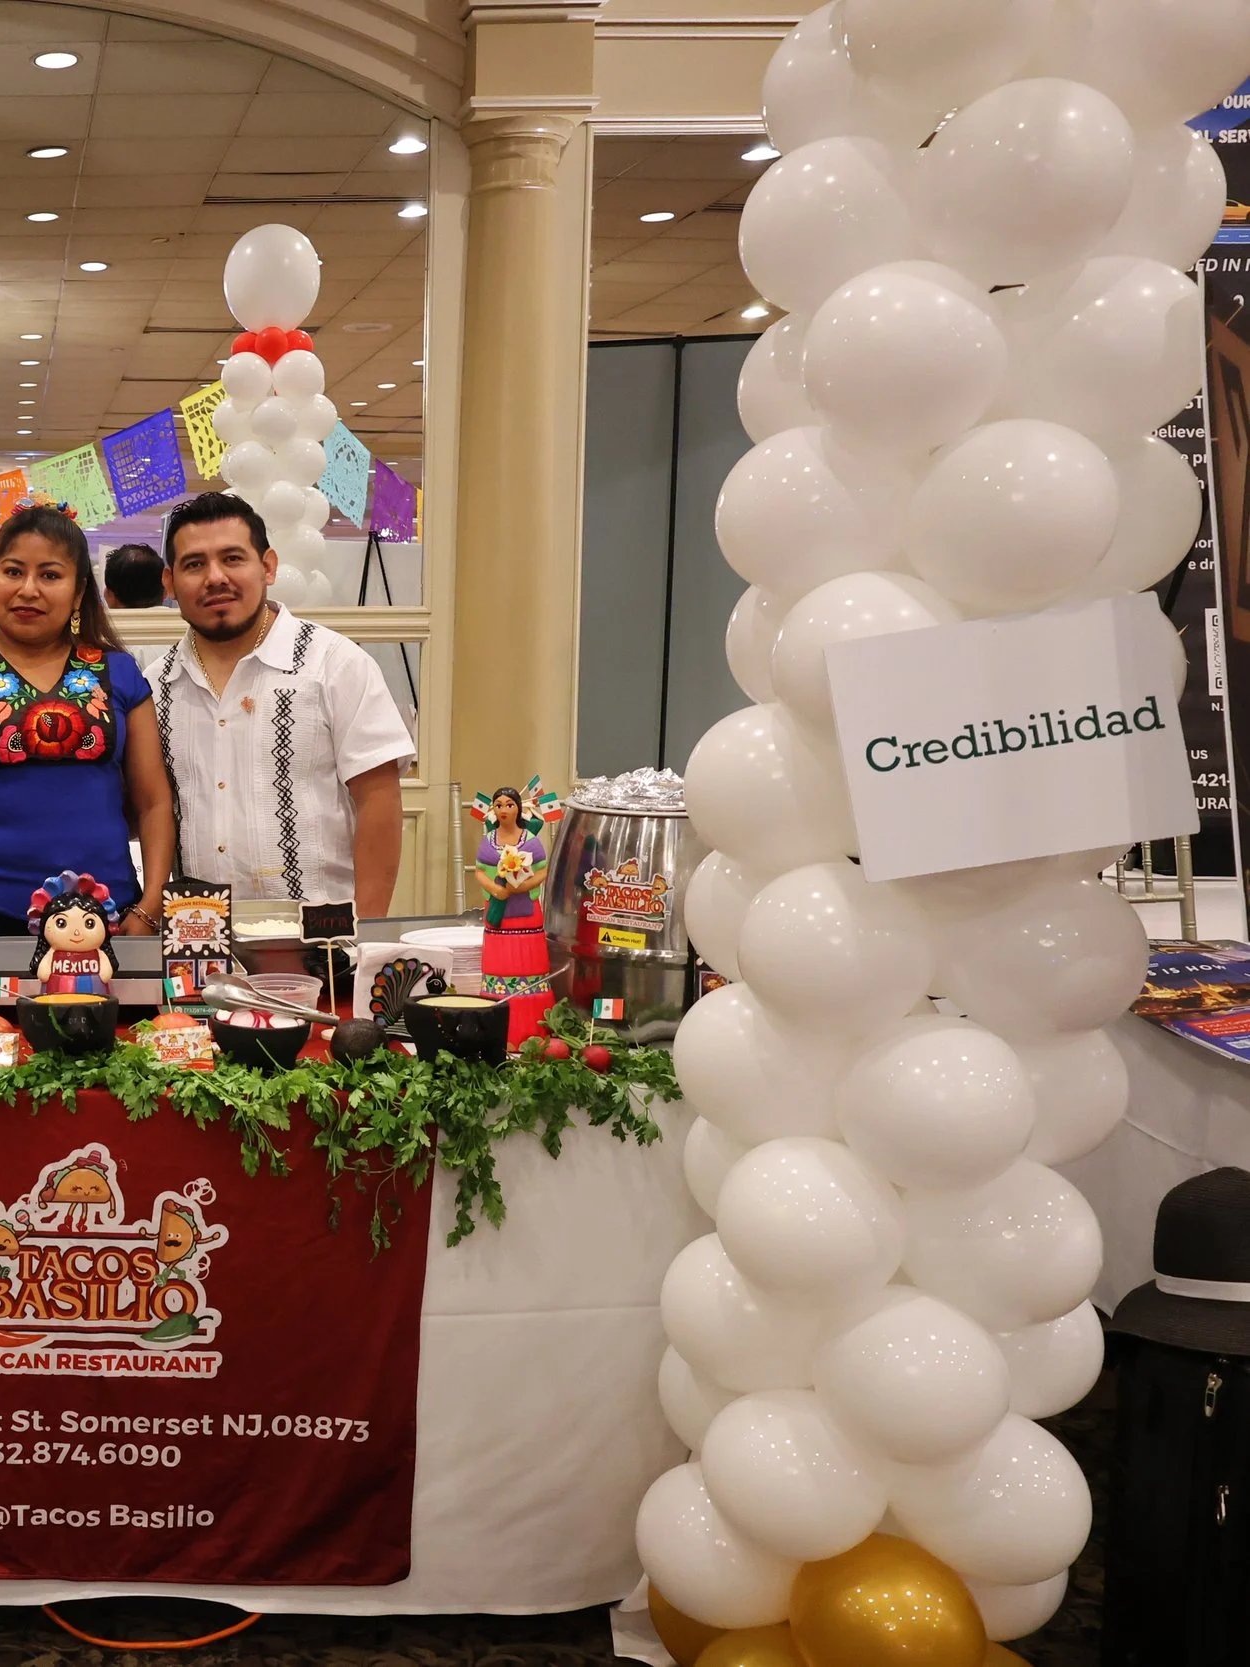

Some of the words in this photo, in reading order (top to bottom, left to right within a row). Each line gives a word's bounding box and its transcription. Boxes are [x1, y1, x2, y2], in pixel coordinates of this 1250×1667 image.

[1222, 258, 1241, 272] IN
[866, 696, 1166, 772] Credibilidad
[1190, 749, 1209, 760] US
[605, 885, 653, 899] TACOS
[595, 893, 664, 913] BASILIO
[53, 960, 99, 973] MEXICO
[16, 1246, 159, 1282] TACOS
[56, 1352, 217, 1373] RESTAURANT
[10, 1409, 51, 1433] St.
[59, 1410, 213, 1436] Somerset
[110, 1504, 215, 1528] Basilio
